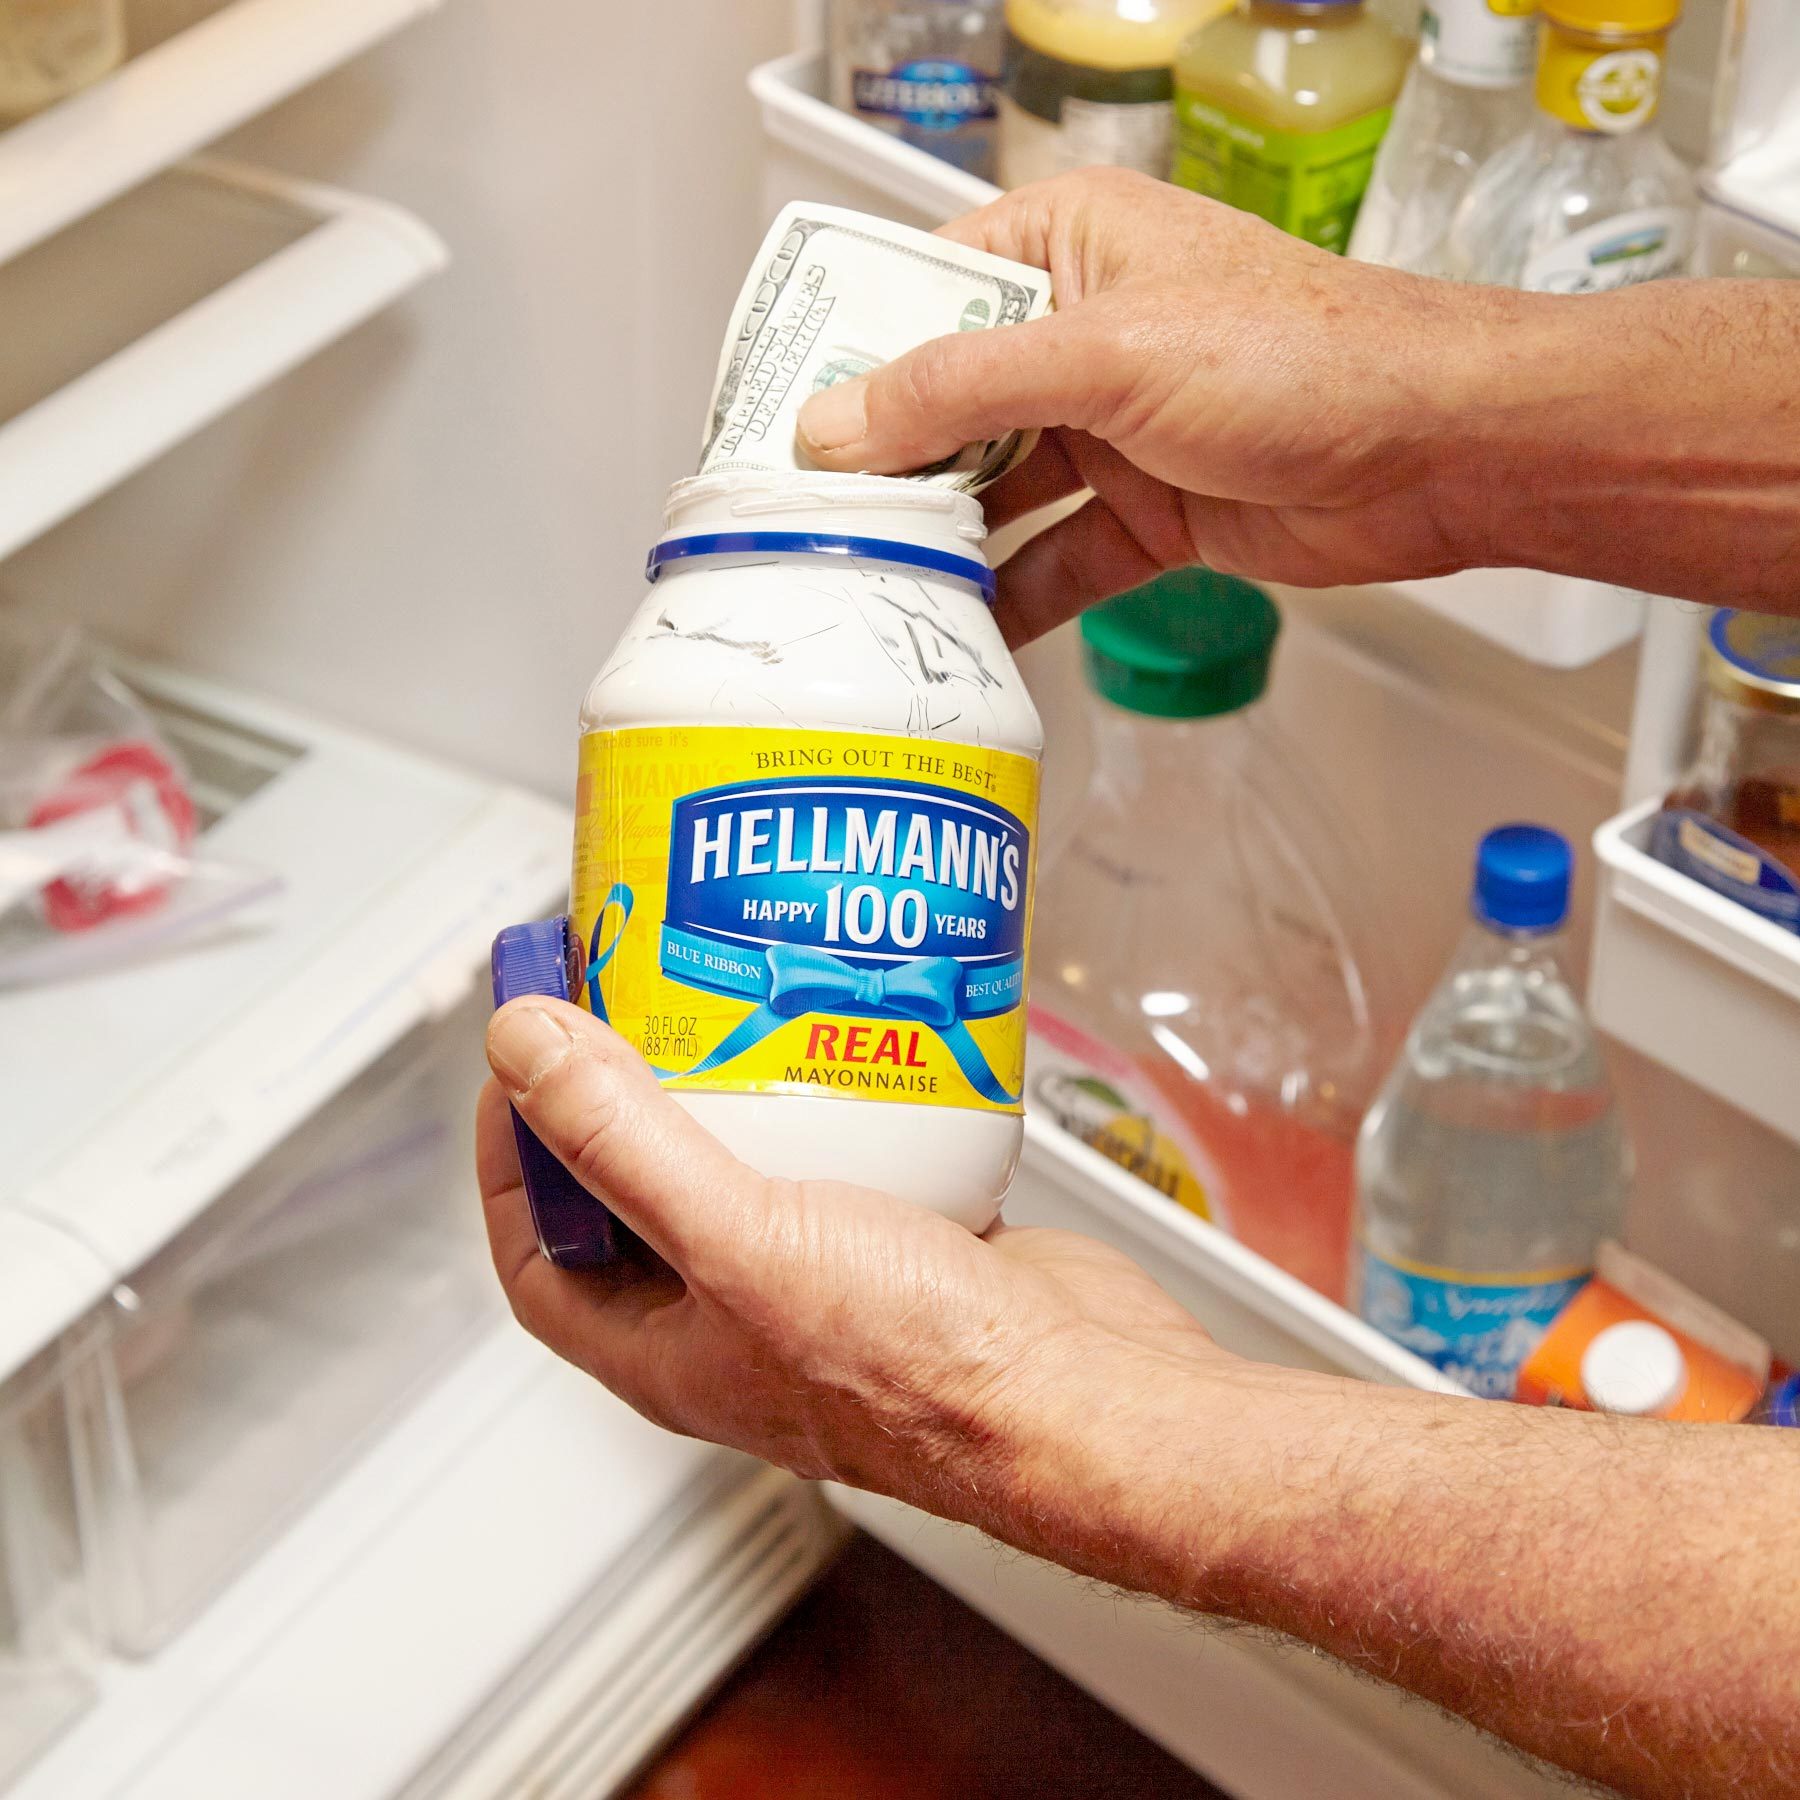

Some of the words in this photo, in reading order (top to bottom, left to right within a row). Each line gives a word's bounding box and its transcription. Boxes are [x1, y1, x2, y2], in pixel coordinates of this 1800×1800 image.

[842, 748, 894, 768] OUT
[902, 752, 946, 776] THE
[690, 806, 1020, 912] HELLMANN'S
[743, 898, 819, 925] HAPPY
[823, 882, 930, 950] 100
[934, 913, 987, 941] YEARS
[666, 940, 701, 965] BLUE
[703, 952, 763, 980] RIBBON
[965, 982, 991, 999] BEST
[643, 1015, 660, 1035] 30
[662, 1015, 676, 1036] FL
[677, 1016, 698, 1037] OZ
[642, 1036, 671, 1058] (887
[804, 1023, 928, 1069] REAL
[783, 1066, 939, 1094] MAYONNAISE
